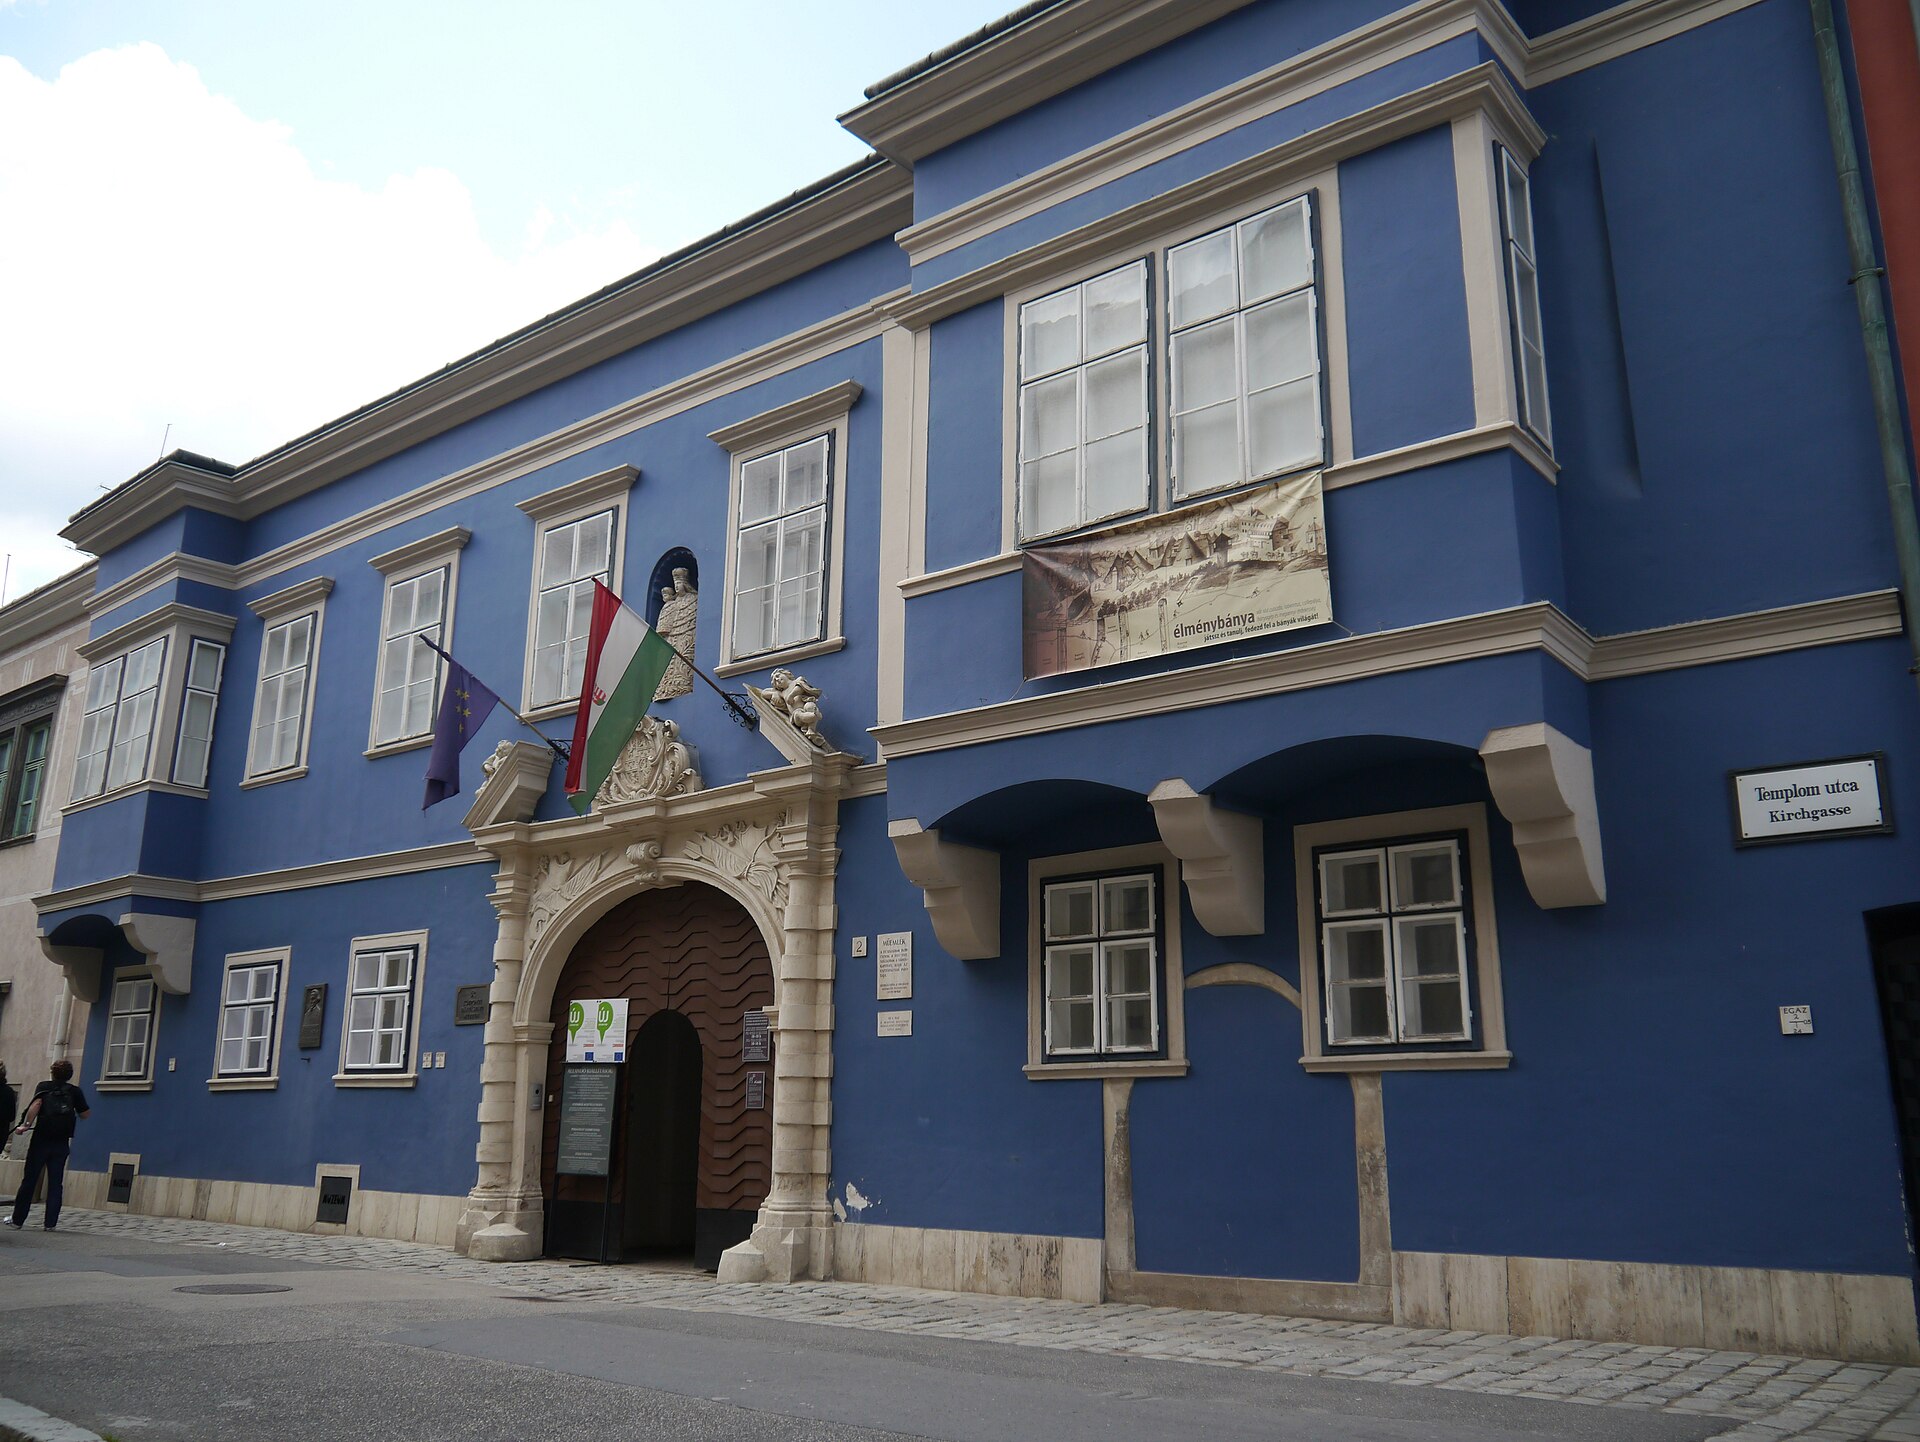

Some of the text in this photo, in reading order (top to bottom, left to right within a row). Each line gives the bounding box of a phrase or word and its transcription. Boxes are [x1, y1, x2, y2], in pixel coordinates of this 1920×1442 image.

[1173, 611, 1255, 638] élménybánya
[1203, 633, 1219, 643] játssz
[1245, 623, 1263, 633] fedezd
[1277, 617, 1296, 627] bányák
[1297, 612, 1319, 623] világát!
[1755, 779, 1859, 803] Templom utca
[1769, 805, 1851, 823] Kirchgasse
[856, 940, 863, 953] 2
